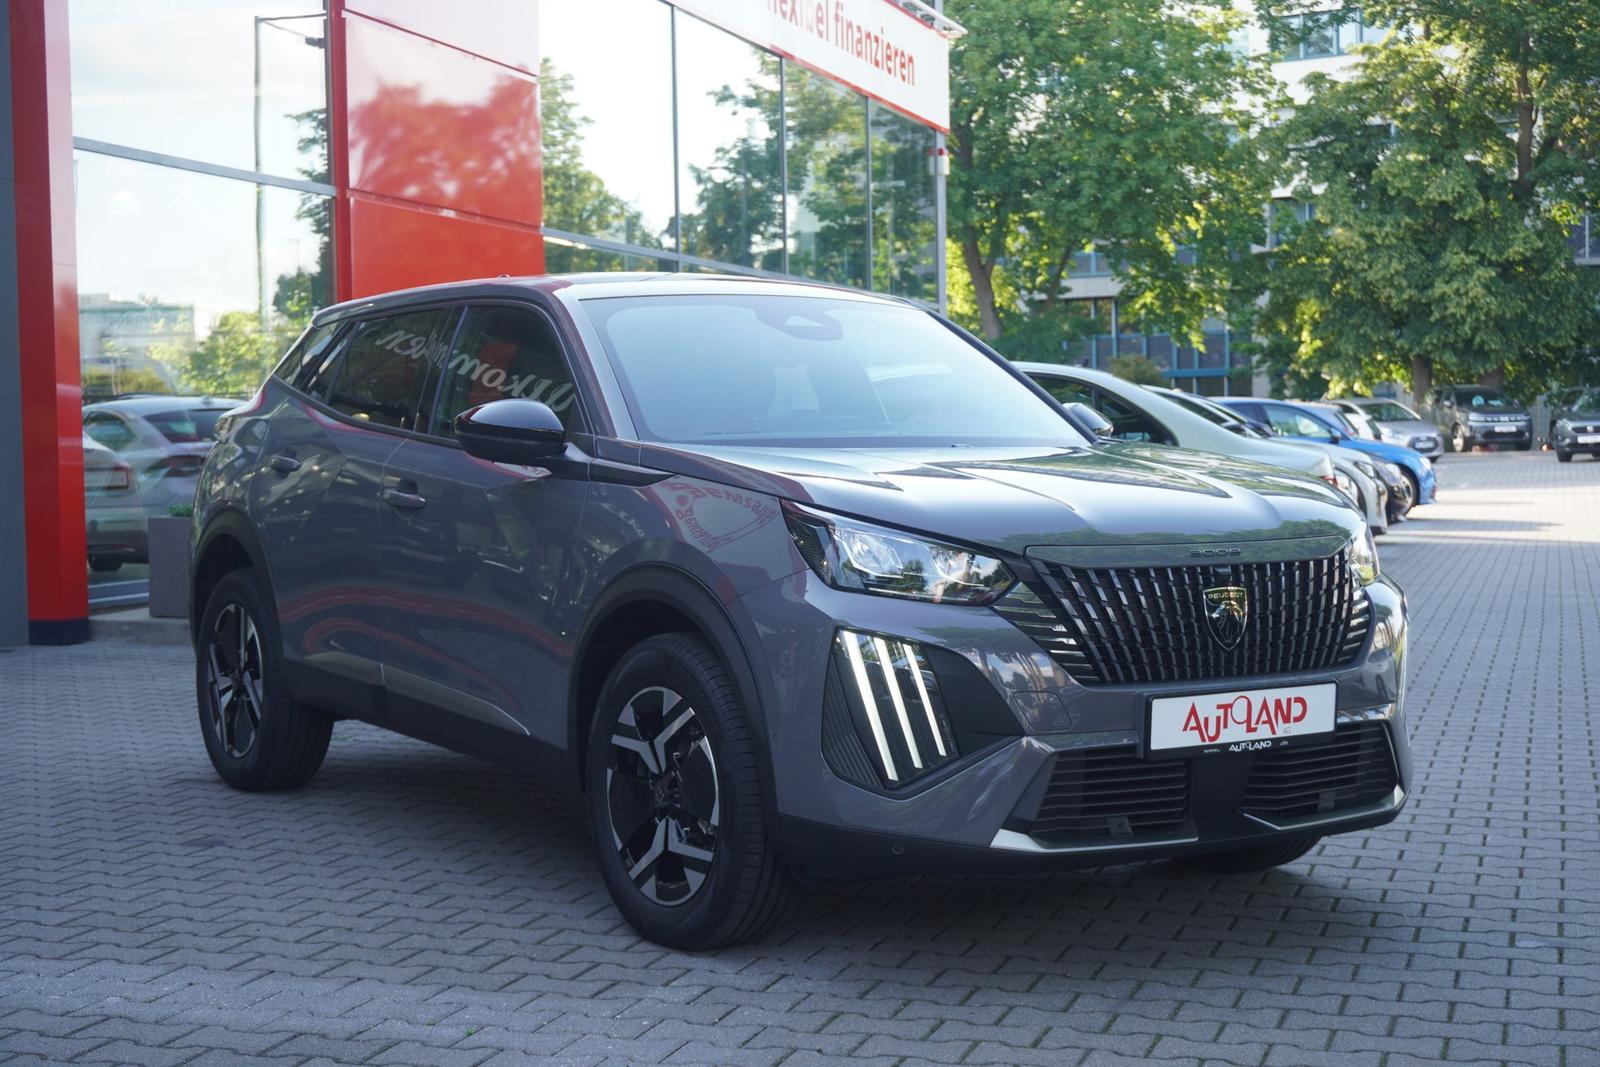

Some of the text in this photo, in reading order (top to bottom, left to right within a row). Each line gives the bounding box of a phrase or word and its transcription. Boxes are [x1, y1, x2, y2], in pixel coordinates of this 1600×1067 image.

[834, 0, 915, 87] finanzieren
[1182, 695, 1308, 743] AUTOLAND
[1229, 740, 1272, 752] AUTOLAND
